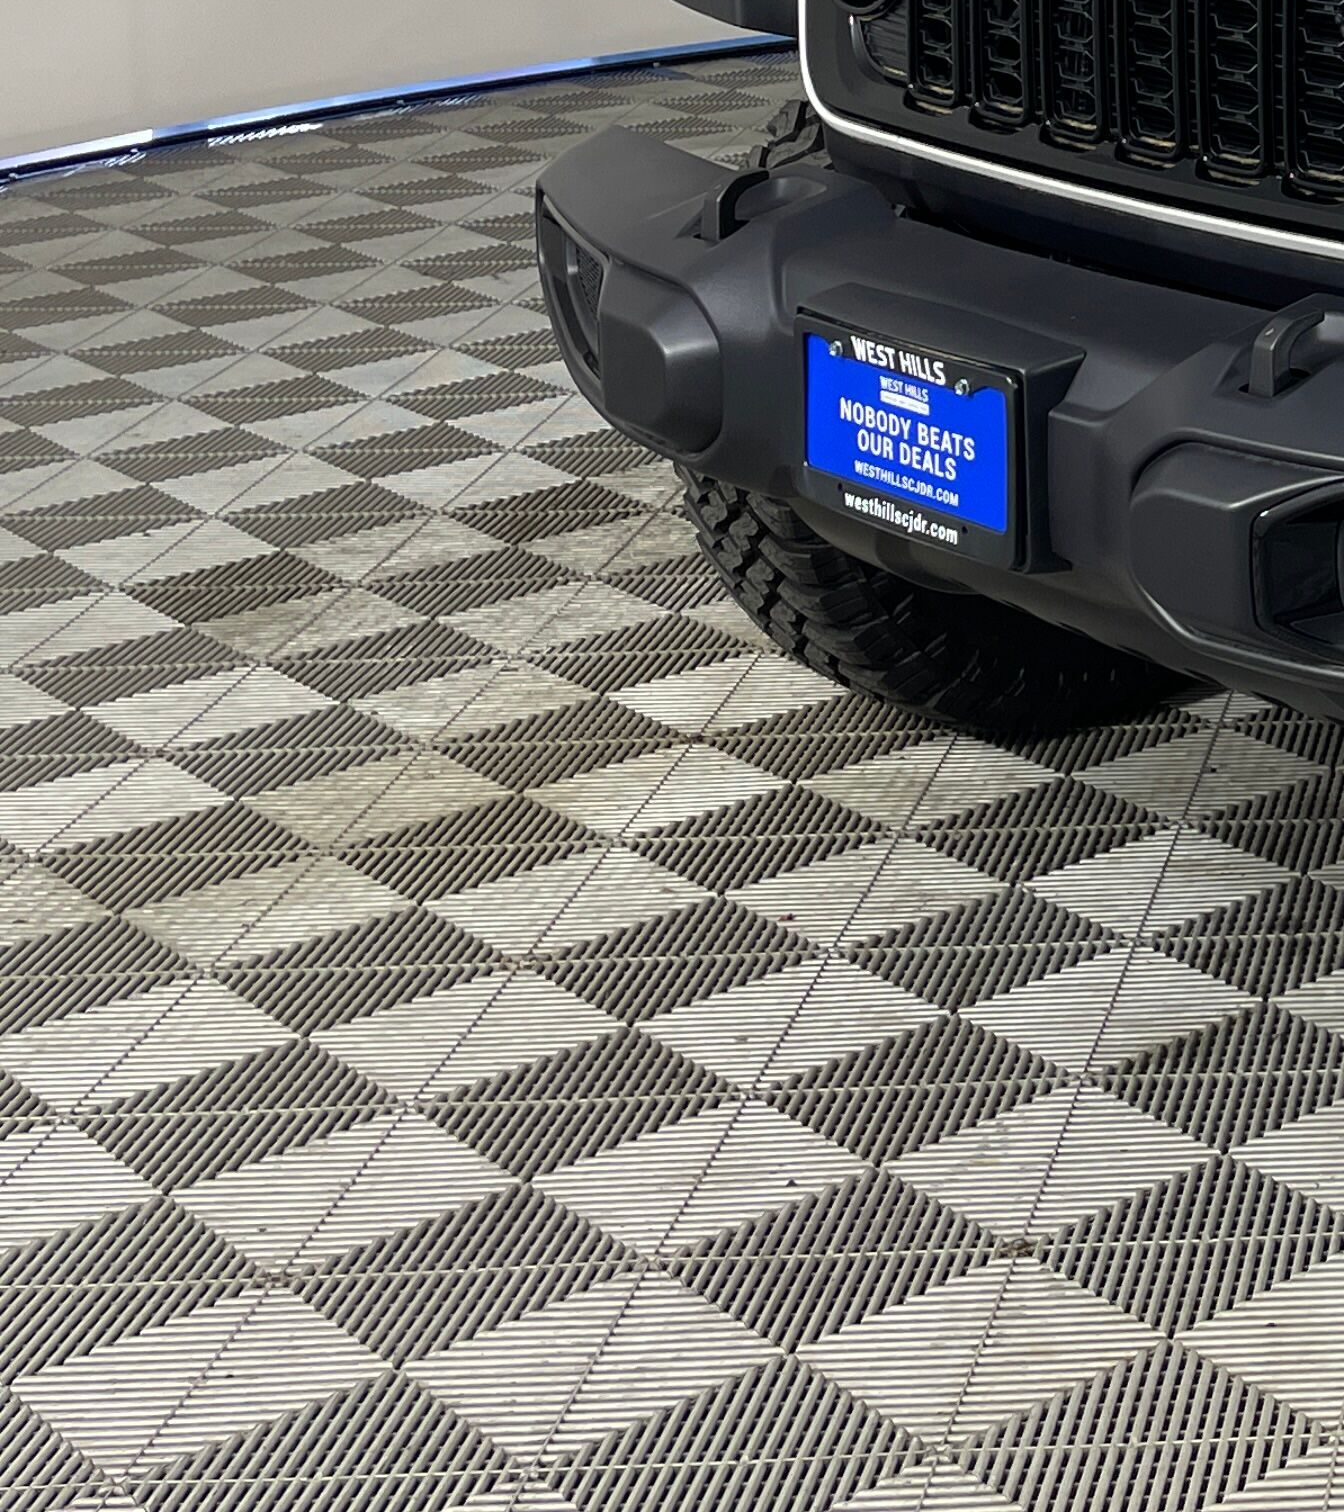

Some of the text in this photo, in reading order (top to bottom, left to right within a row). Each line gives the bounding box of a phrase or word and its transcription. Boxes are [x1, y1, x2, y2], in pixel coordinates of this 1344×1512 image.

[850, 335, 947, 386] WEST HILLS
[879, 375, 904, 394] WEST
[904, 383, 929, 403] HILLS
[839, 396, 912, 439] NOBODY
[917, 422, 976, 461] BEATS
[856, 428, 957, 481] OUR DEALS
[854, 459, 959, 507] WESTHILLSCJDR.COM
[844, 492, 958, 545] westhillscjdr.com
